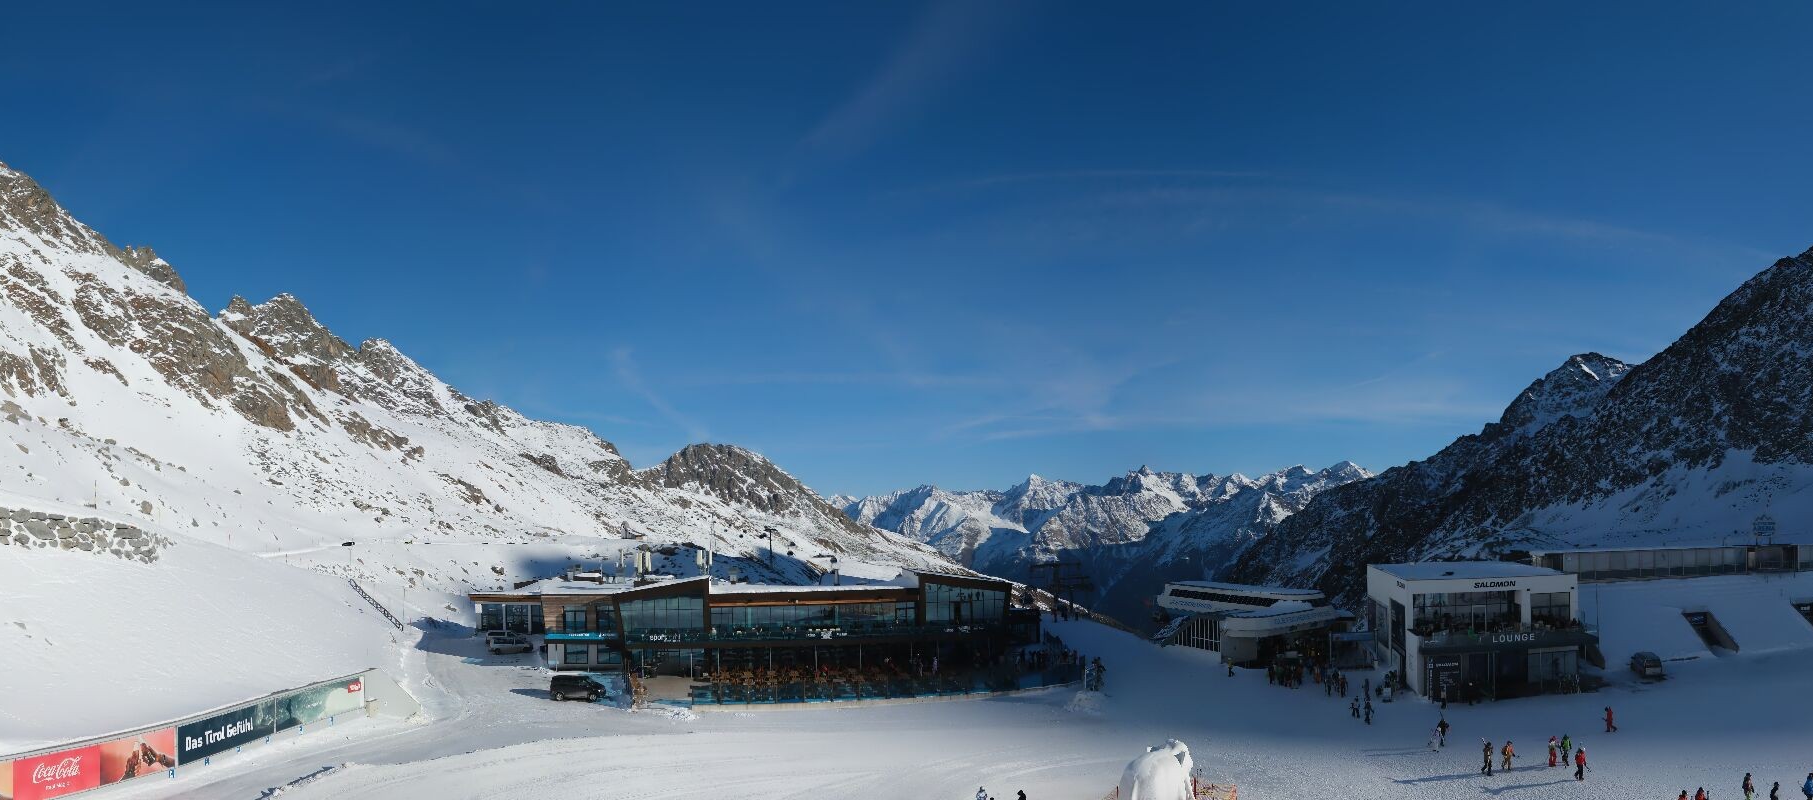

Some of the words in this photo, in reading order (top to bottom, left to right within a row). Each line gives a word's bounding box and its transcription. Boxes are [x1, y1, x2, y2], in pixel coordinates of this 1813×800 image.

[1473, 580, 1516, 589] SALOMON
[1492, 633, 1536, 643] LOUNGE
[185, 736, 203, 752] Das
[204, 726, 225, 745] Tirol
[226, 717, 254, 738] Gefühl
[32, 756, 83, 784] Coca-Cola
